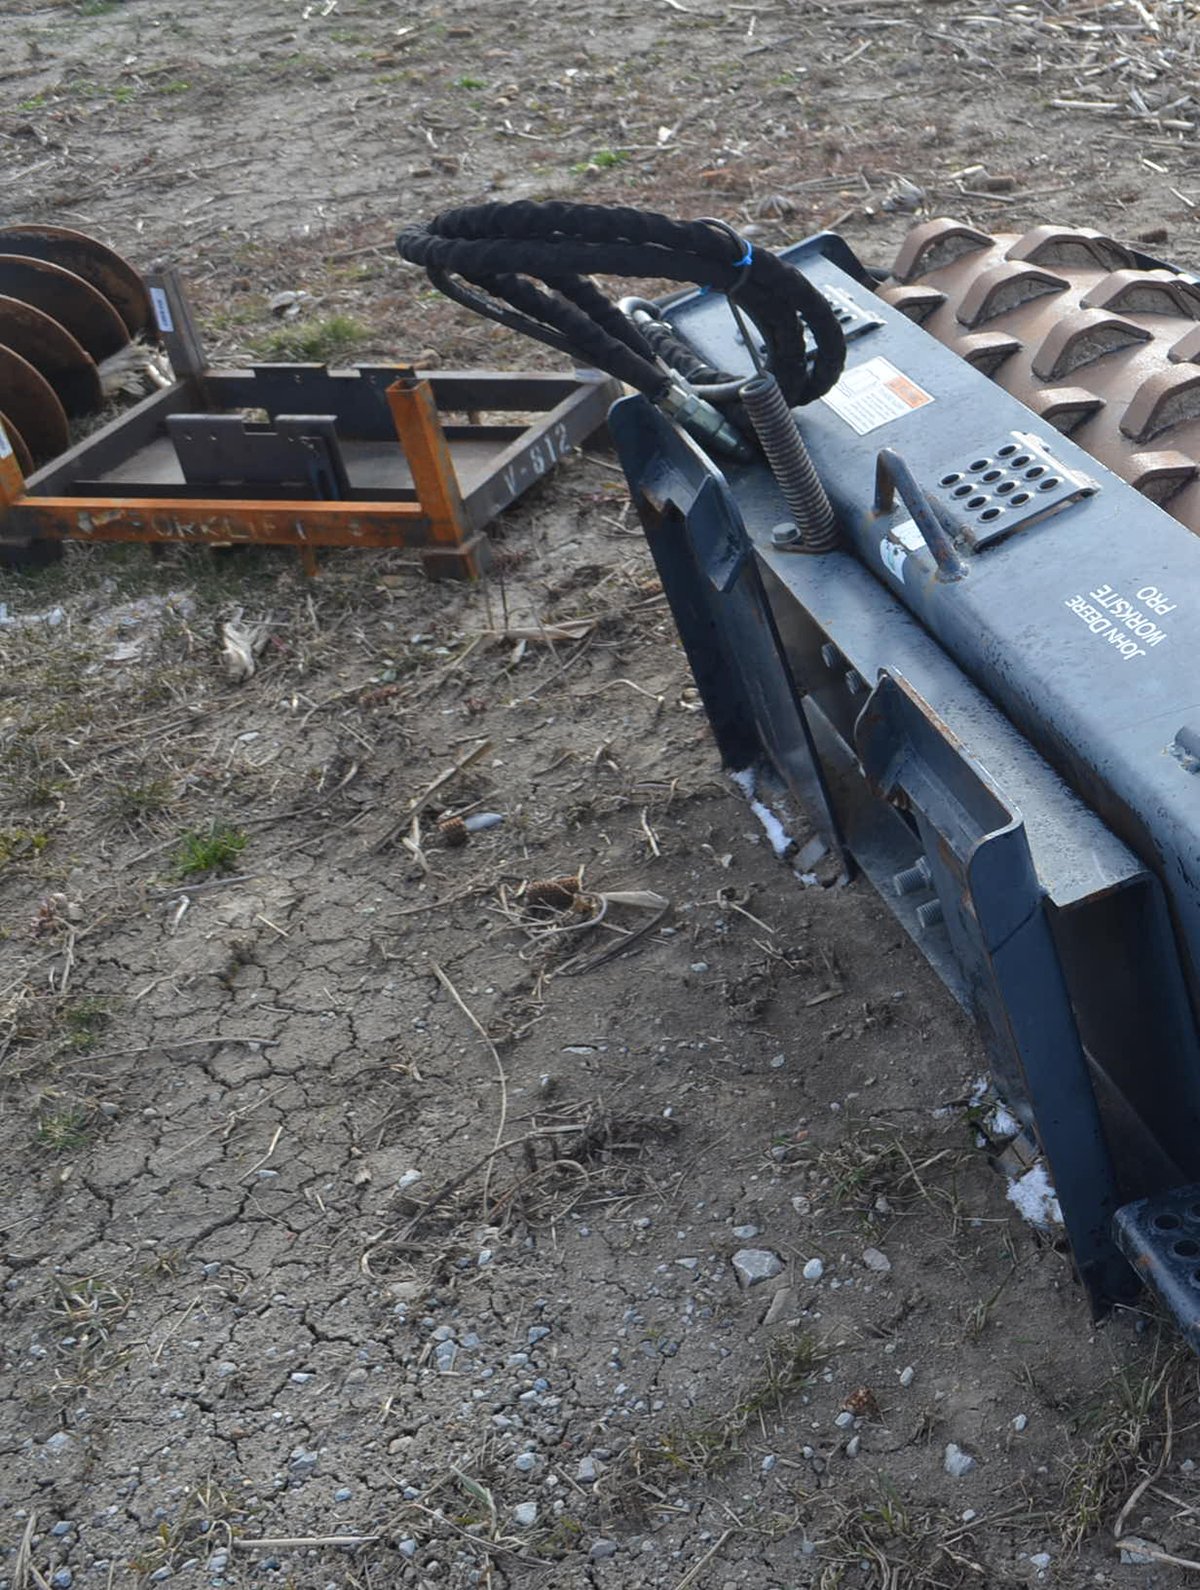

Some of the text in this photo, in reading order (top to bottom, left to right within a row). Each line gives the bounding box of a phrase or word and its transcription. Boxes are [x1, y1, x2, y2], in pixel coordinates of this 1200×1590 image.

[1064, 594, 1147, 661] JOHN DEERE
[1088, 583, 1168, 647] WORKSITE
[1135, 586, 1178, 616] PRO
